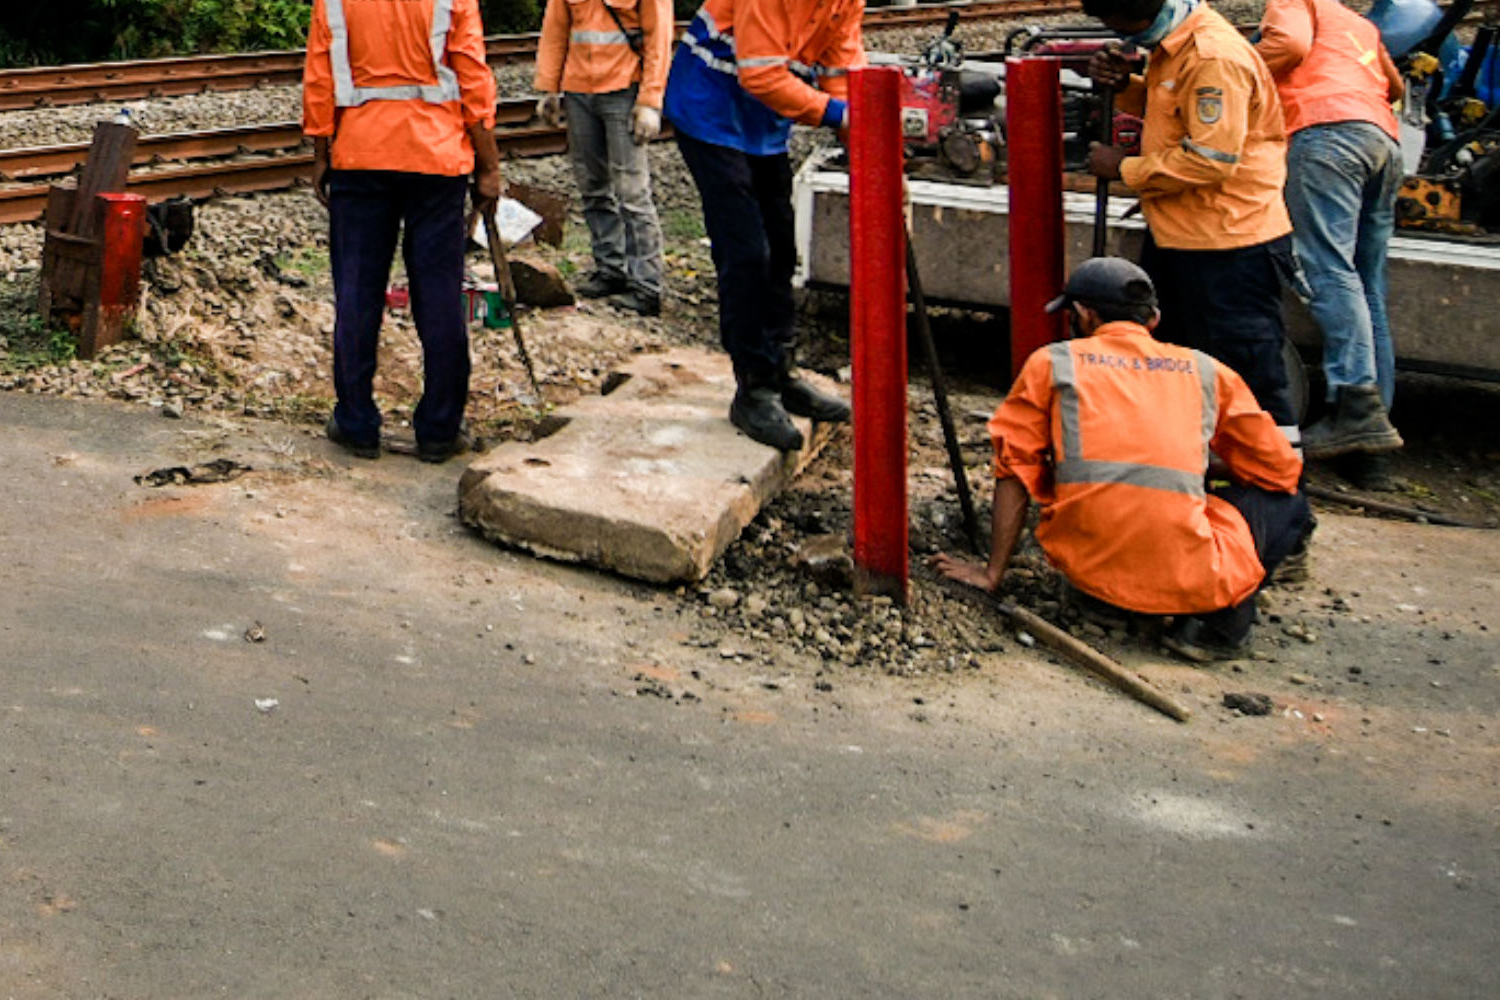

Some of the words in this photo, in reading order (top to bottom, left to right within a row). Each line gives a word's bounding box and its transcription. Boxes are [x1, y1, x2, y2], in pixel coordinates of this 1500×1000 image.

[1078, 352, 1127, 369] TRACK
[1133, 357, 1142, 370] &
[1144, 356, 1192, 374] BRIDGE
